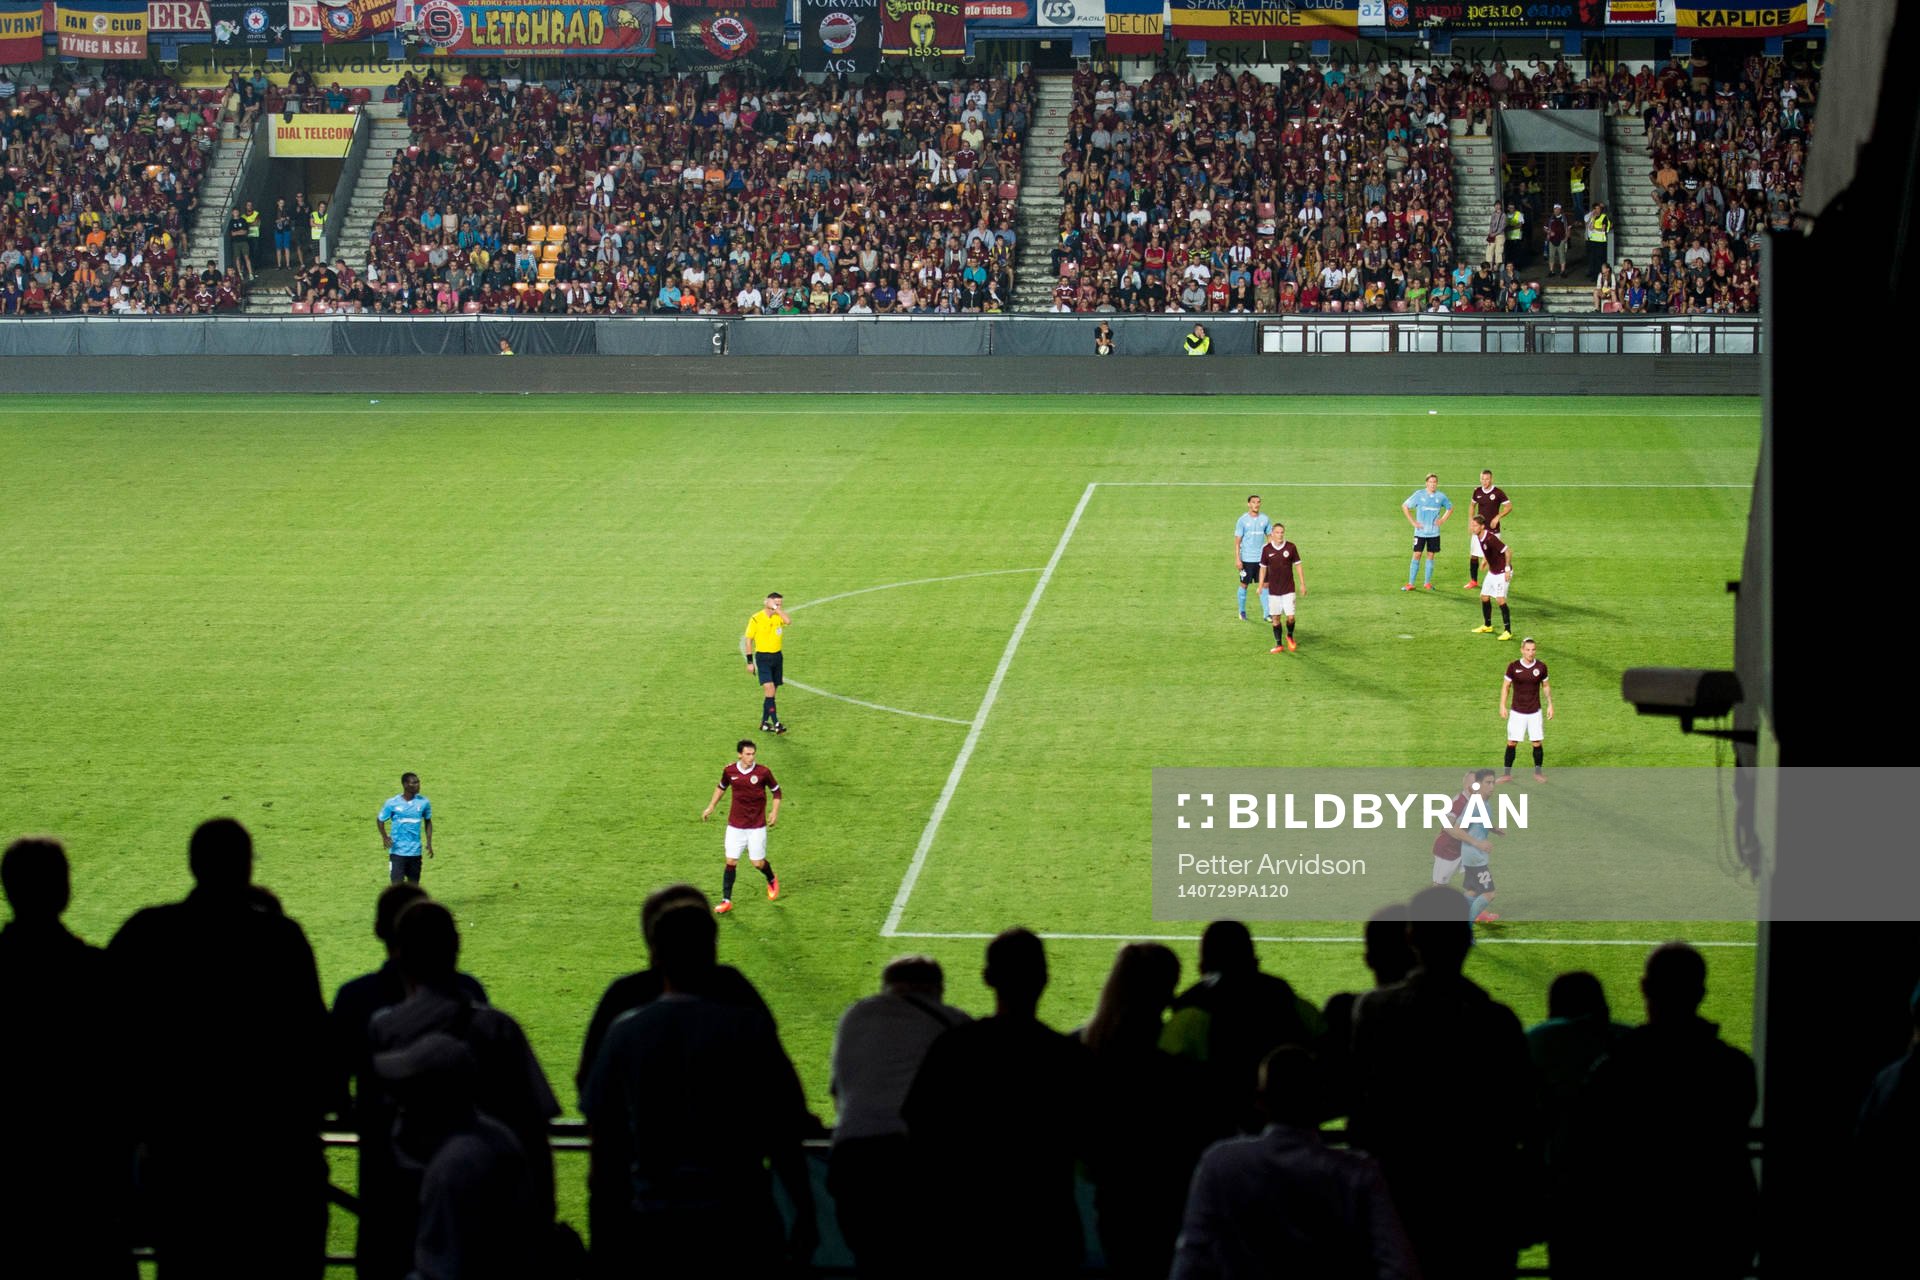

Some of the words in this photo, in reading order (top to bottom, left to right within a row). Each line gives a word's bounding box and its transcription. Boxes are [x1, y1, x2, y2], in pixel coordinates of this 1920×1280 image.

[66, 15, 87, 29] FAN
[111, 19, 142, 31] CLUB
[1697, 10, 1791, 27] KAPLICE
[470, 9, 605, 46] LETOHRAD
[61, 35, 100, 54] TÝNEC
[908, 48, 942, 57] 1893
[824, 60, 856, 72] ACS
[277, 127, 302, 140] DIAL
[304, 127, 352, 140] TELECOM
